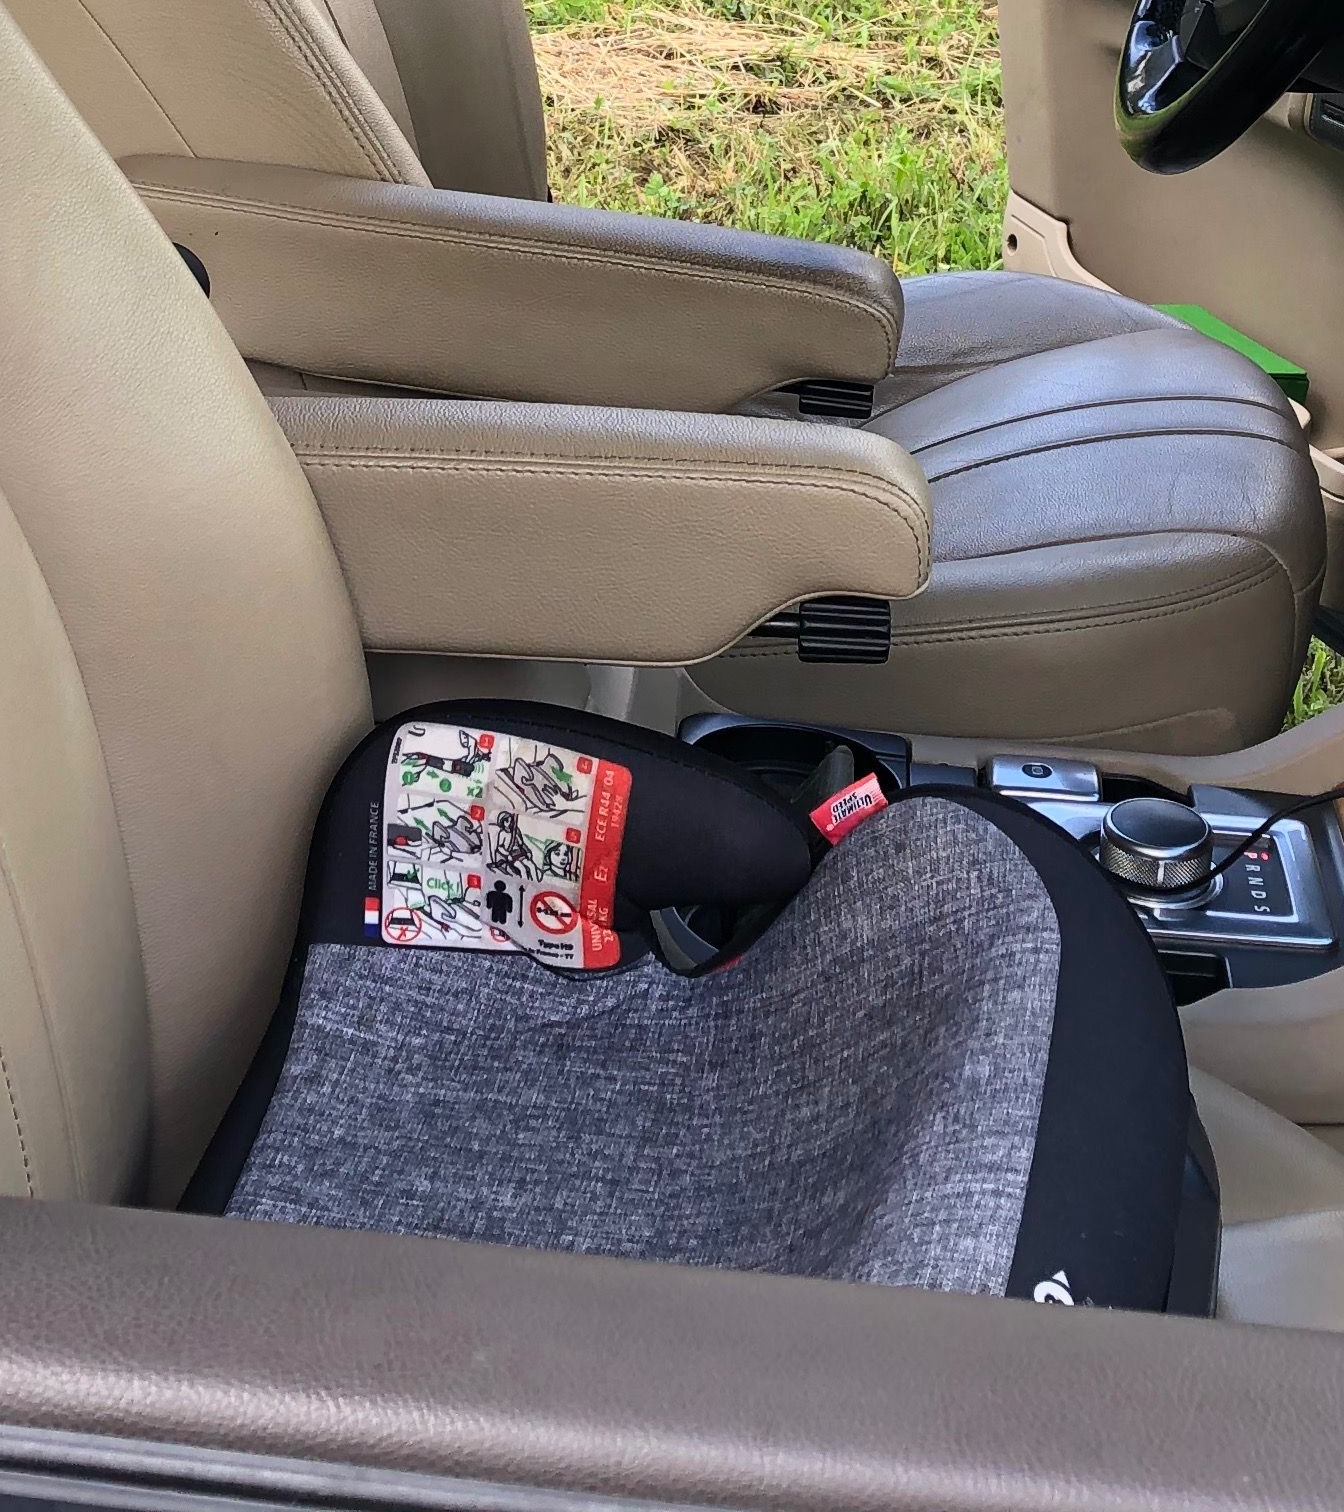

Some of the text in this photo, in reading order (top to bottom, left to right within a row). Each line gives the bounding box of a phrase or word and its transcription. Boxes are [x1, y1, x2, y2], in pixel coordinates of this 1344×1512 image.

[833, 792, 857, 812] SPEED
[834, 794, 872, 823] ULTIMATE
[595, 821, 607, 842] ECE
[368, 802, 379, 891] MADE IN FRANCE
[1245, 864, 1260, 872] R
[1248, 877, 1264, 885] N
[1251, 890, 1266, 899] D
[587, 899, 602, 952] UNIVSAL
